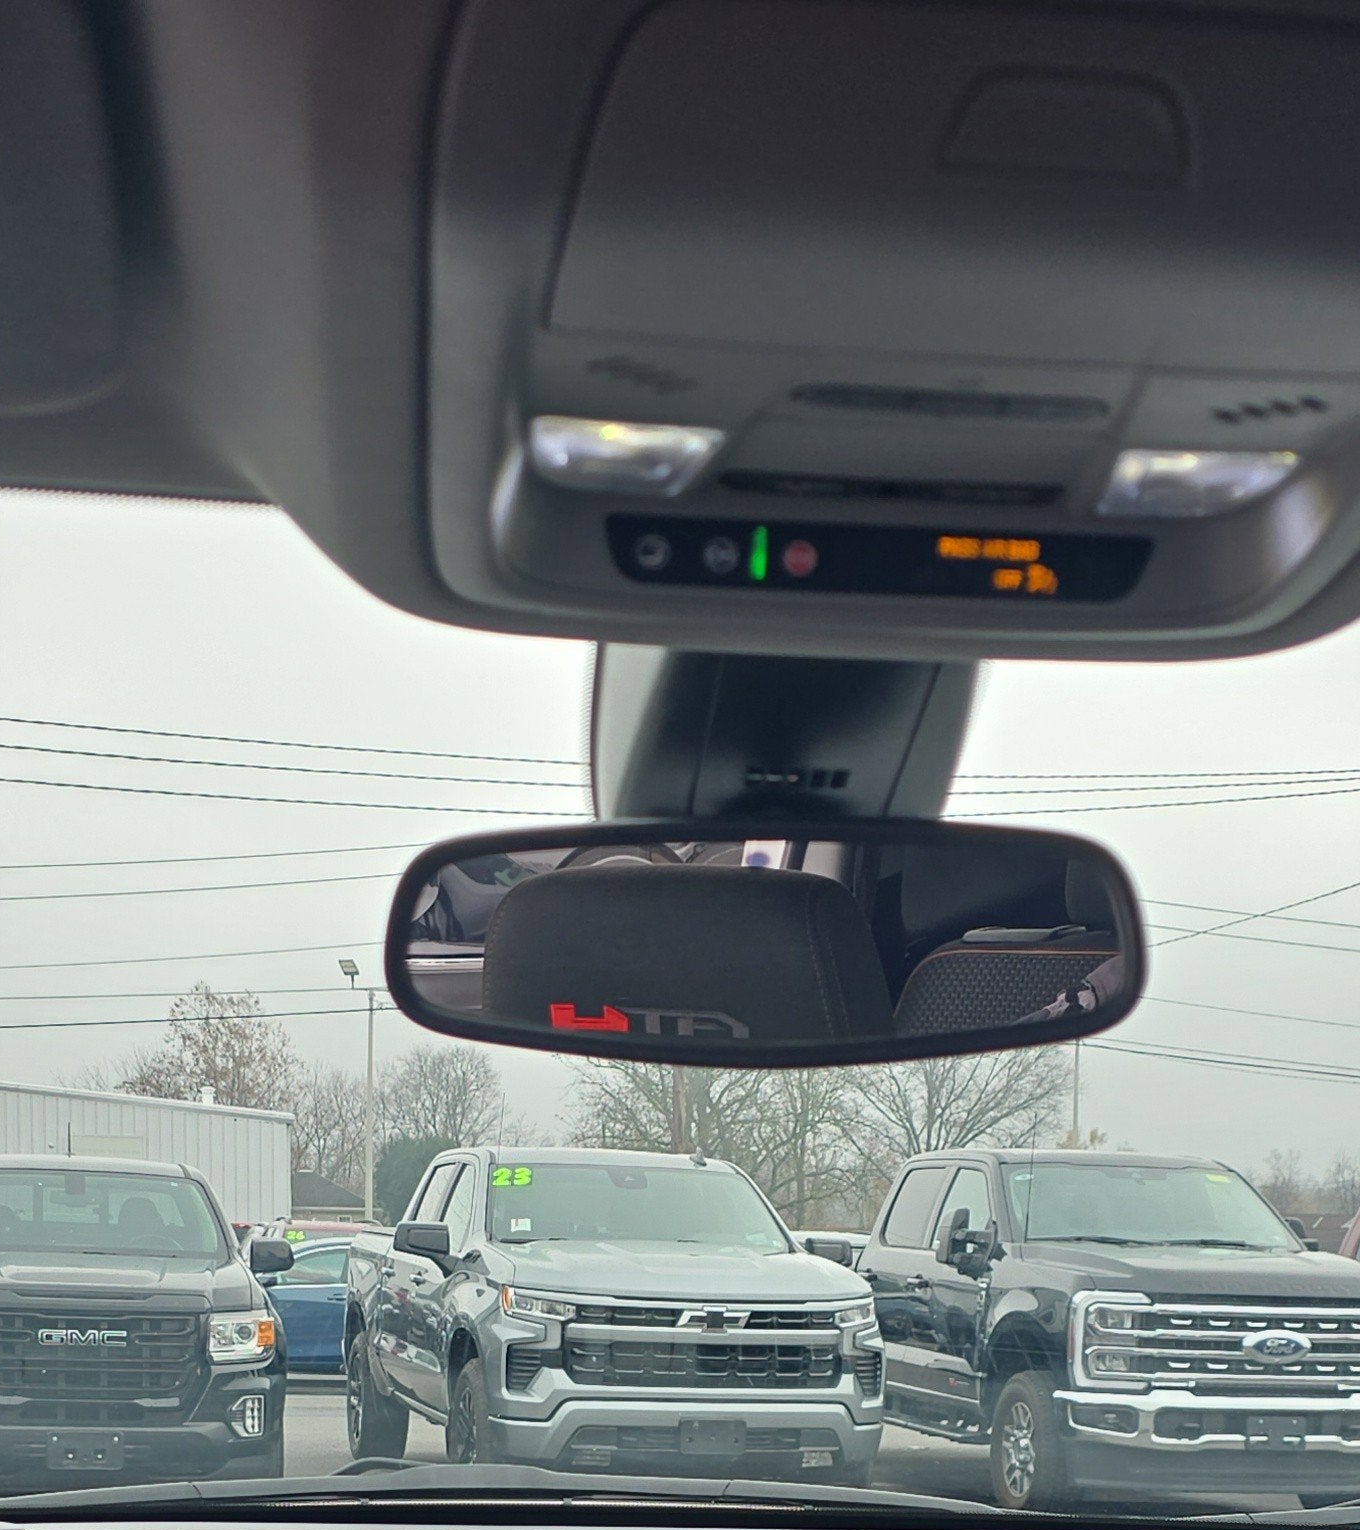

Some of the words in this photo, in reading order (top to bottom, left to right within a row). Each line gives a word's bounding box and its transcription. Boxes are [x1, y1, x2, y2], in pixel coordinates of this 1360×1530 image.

[492, 1167, 532, 1186] 23
[38, 1329, 128, 1348] GMC
[1262, 1338, 1296, 1355] Ford
